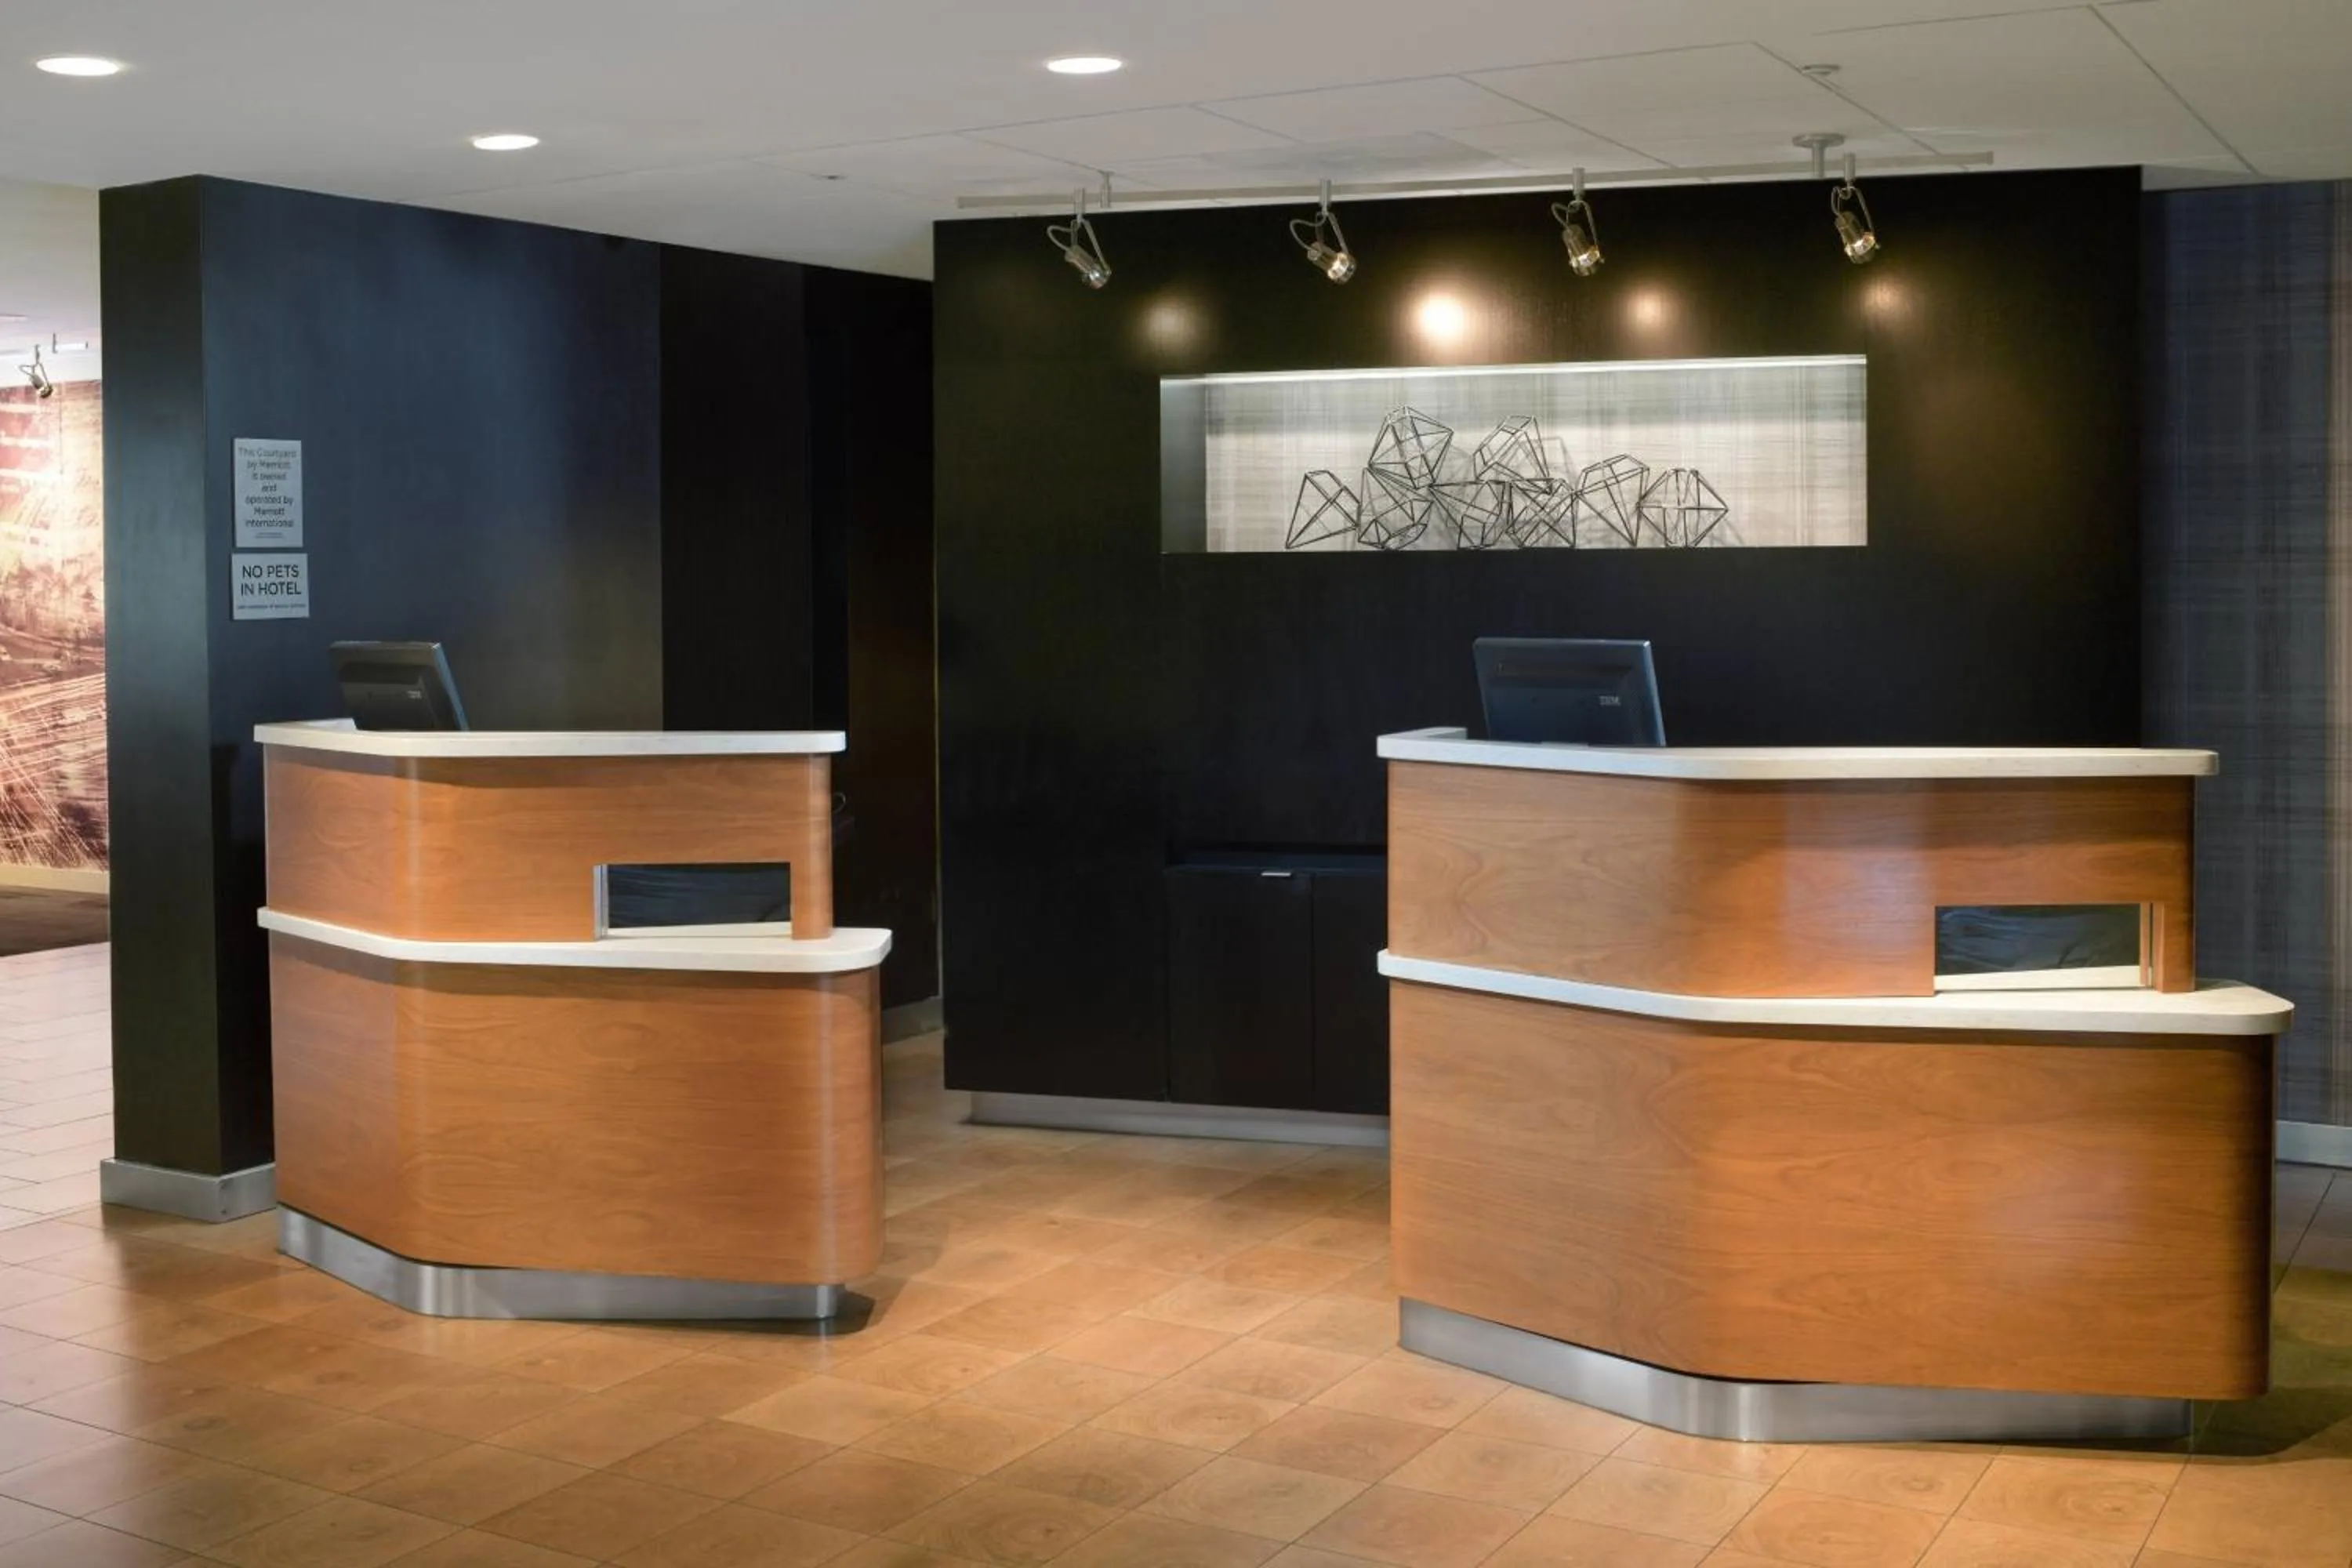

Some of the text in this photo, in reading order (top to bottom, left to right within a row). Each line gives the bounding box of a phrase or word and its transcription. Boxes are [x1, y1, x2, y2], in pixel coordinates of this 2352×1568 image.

[261, 483, 277, 492] and
[283, 495, 294, 506] by
[242, 564, 299, 578] NO PETS
[241, 581, 302, 596] IN HOTEL
